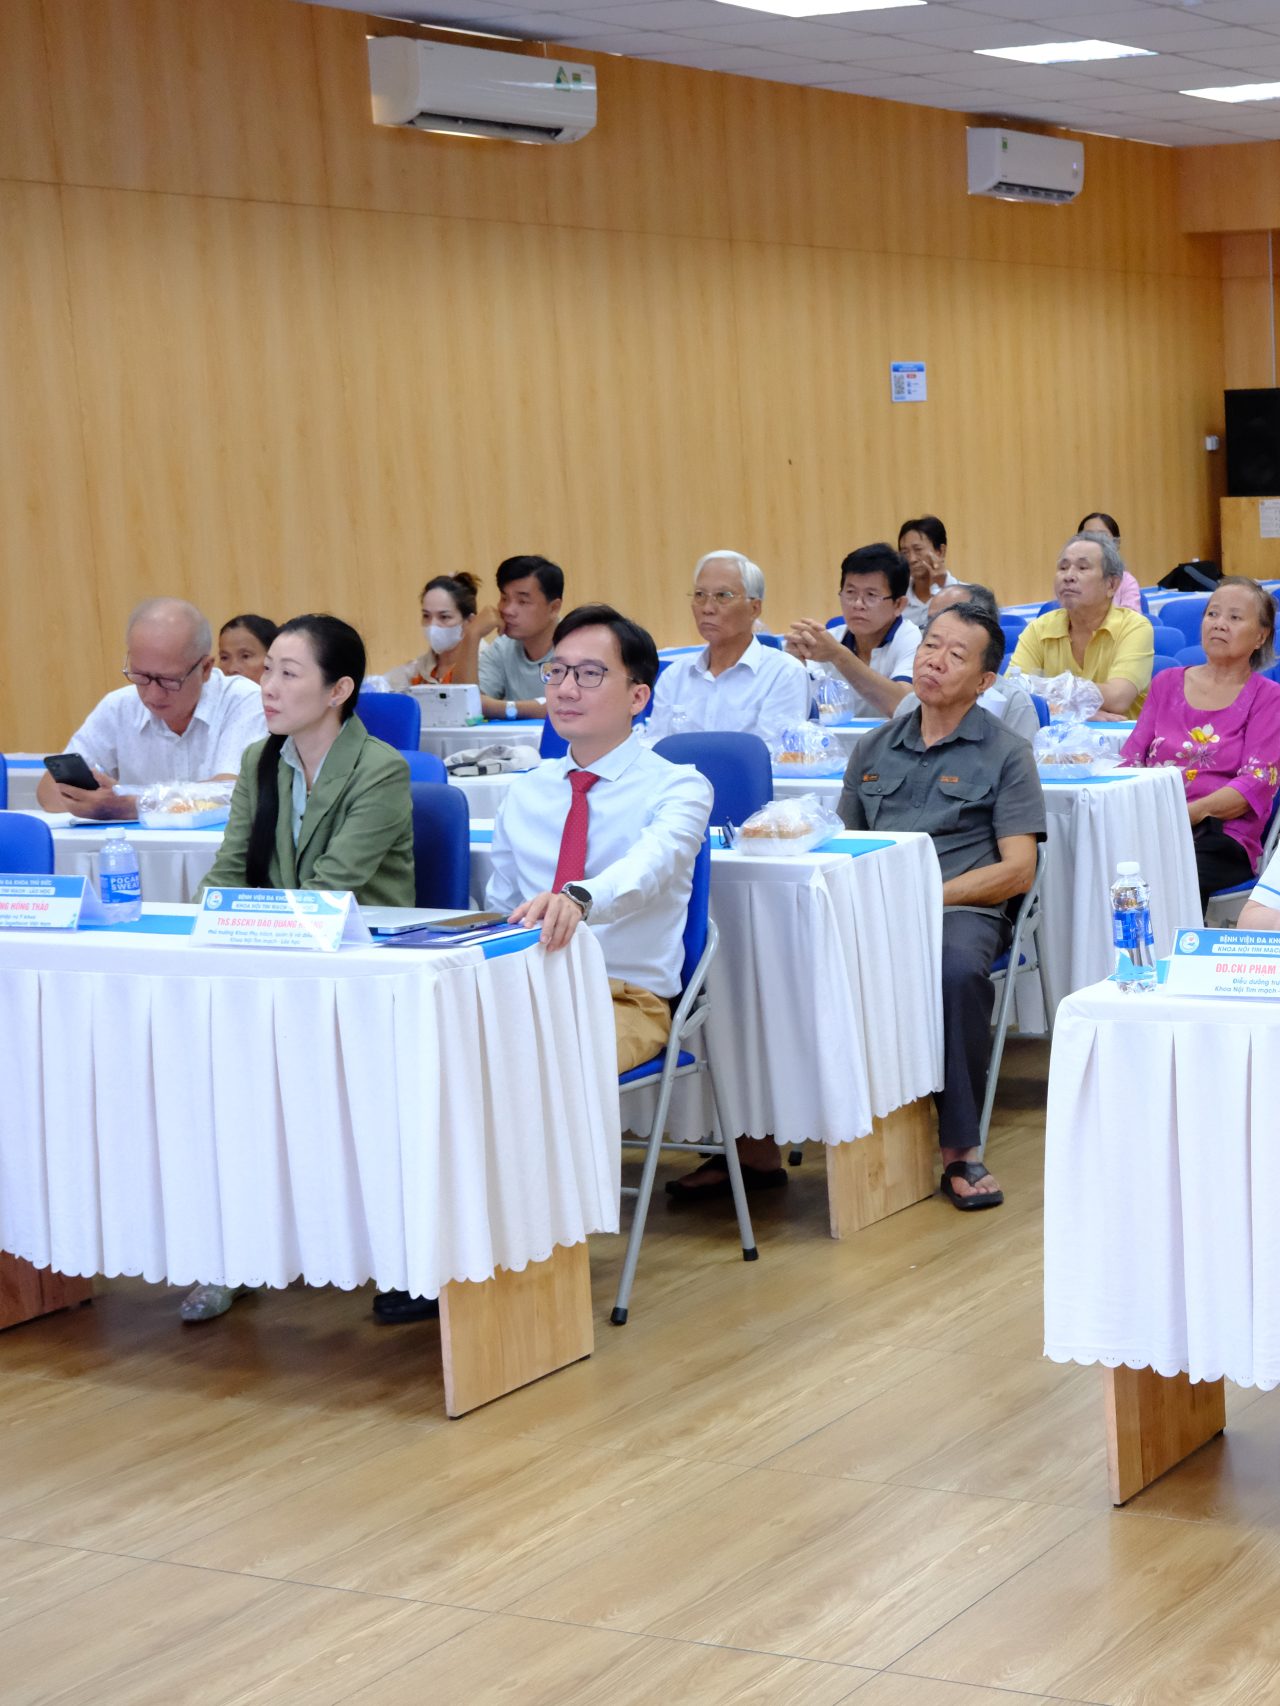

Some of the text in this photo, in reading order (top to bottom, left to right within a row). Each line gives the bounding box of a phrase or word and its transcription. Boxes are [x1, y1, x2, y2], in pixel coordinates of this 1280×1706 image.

[111, 882, 138, 891] SWEA
[1220, 934, 1238, 944] BỆNH
[1240, 935, 1255, 944] VIỆN
[1256, 936, 1267, 944] ĐA
[1215, 963, 1247, 973] ĐD.CKI
[1248, 964, 1276, 976] PHẠM
